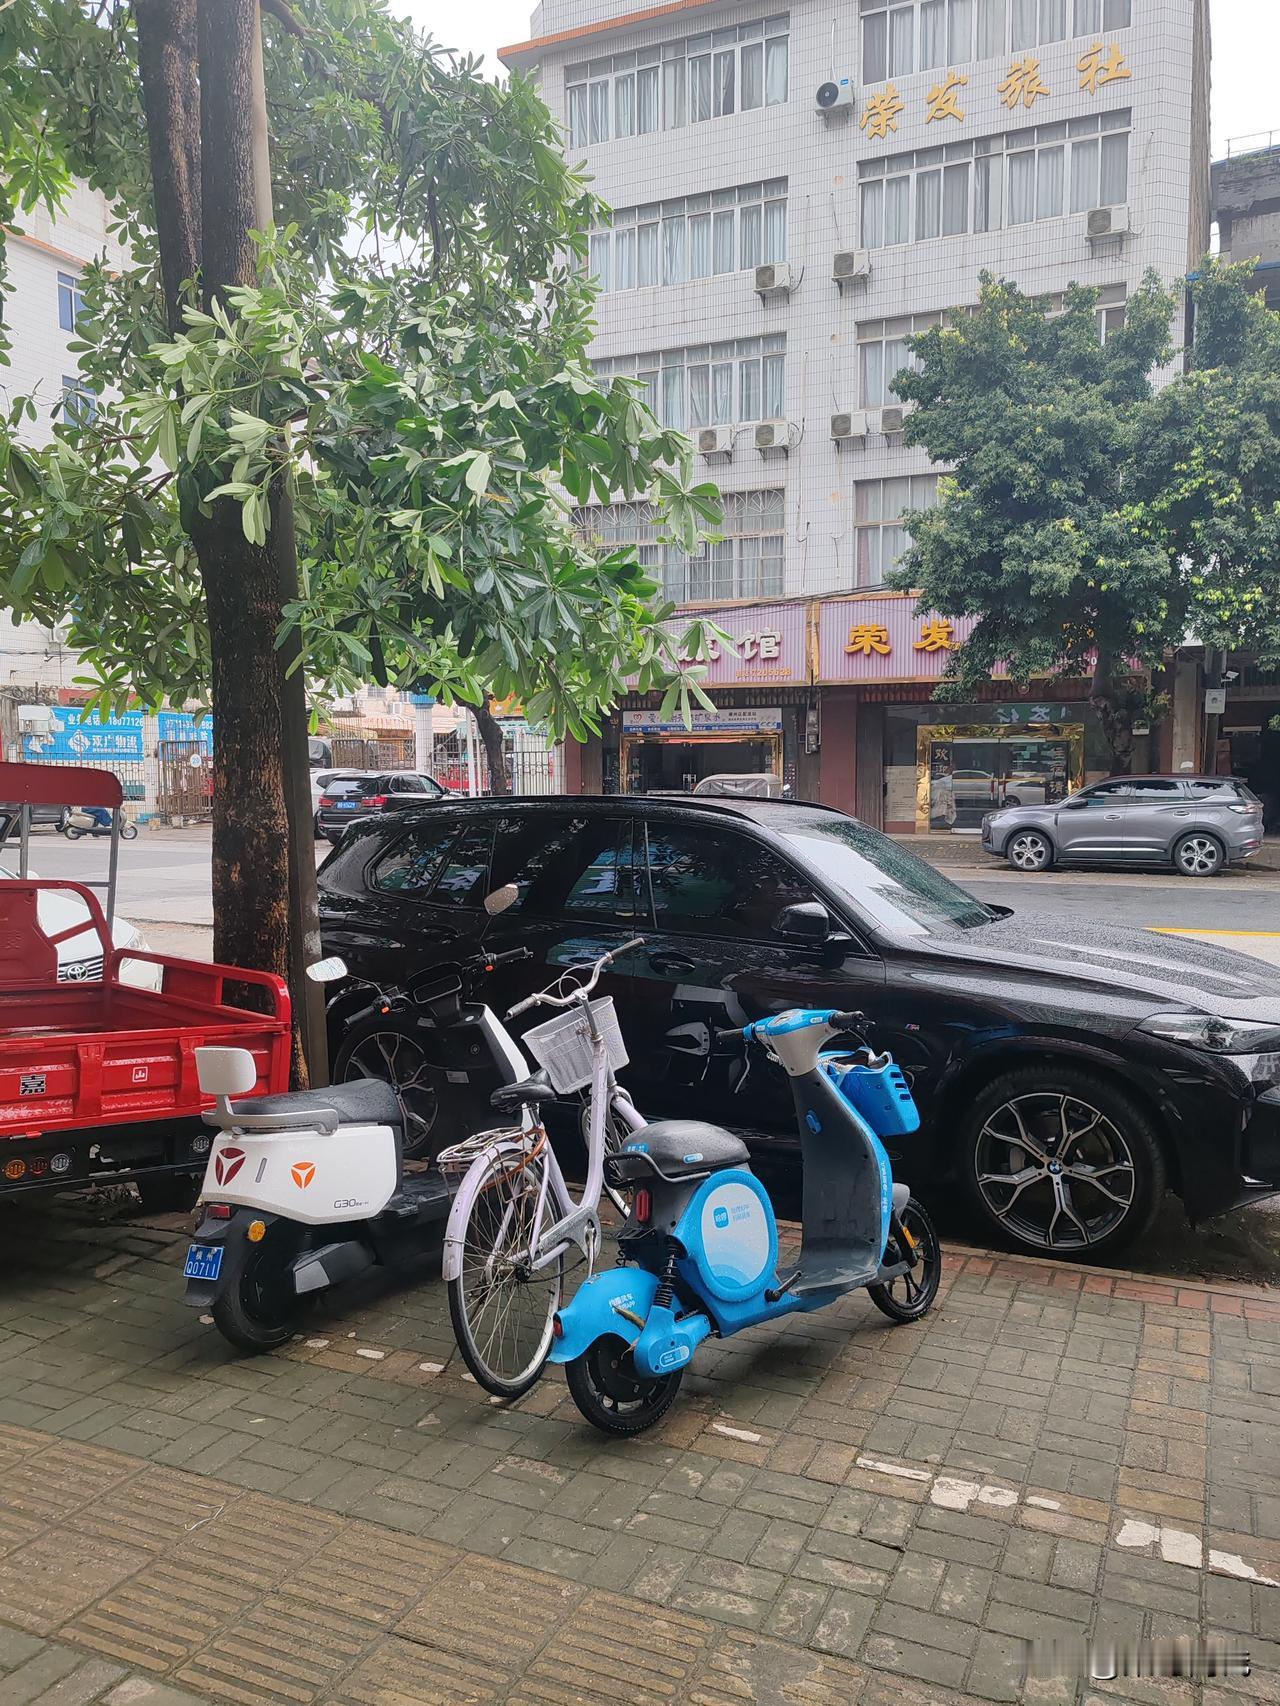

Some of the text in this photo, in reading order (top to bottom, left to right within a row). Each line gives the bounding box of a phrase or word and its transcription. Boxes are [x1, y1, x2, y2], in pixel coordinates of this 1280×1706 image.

[859, 40, 1132, 139] 荣发旅社
[334, 1199, 356, 1208] G30
[186, 1261, 216, 1277] Q0711
